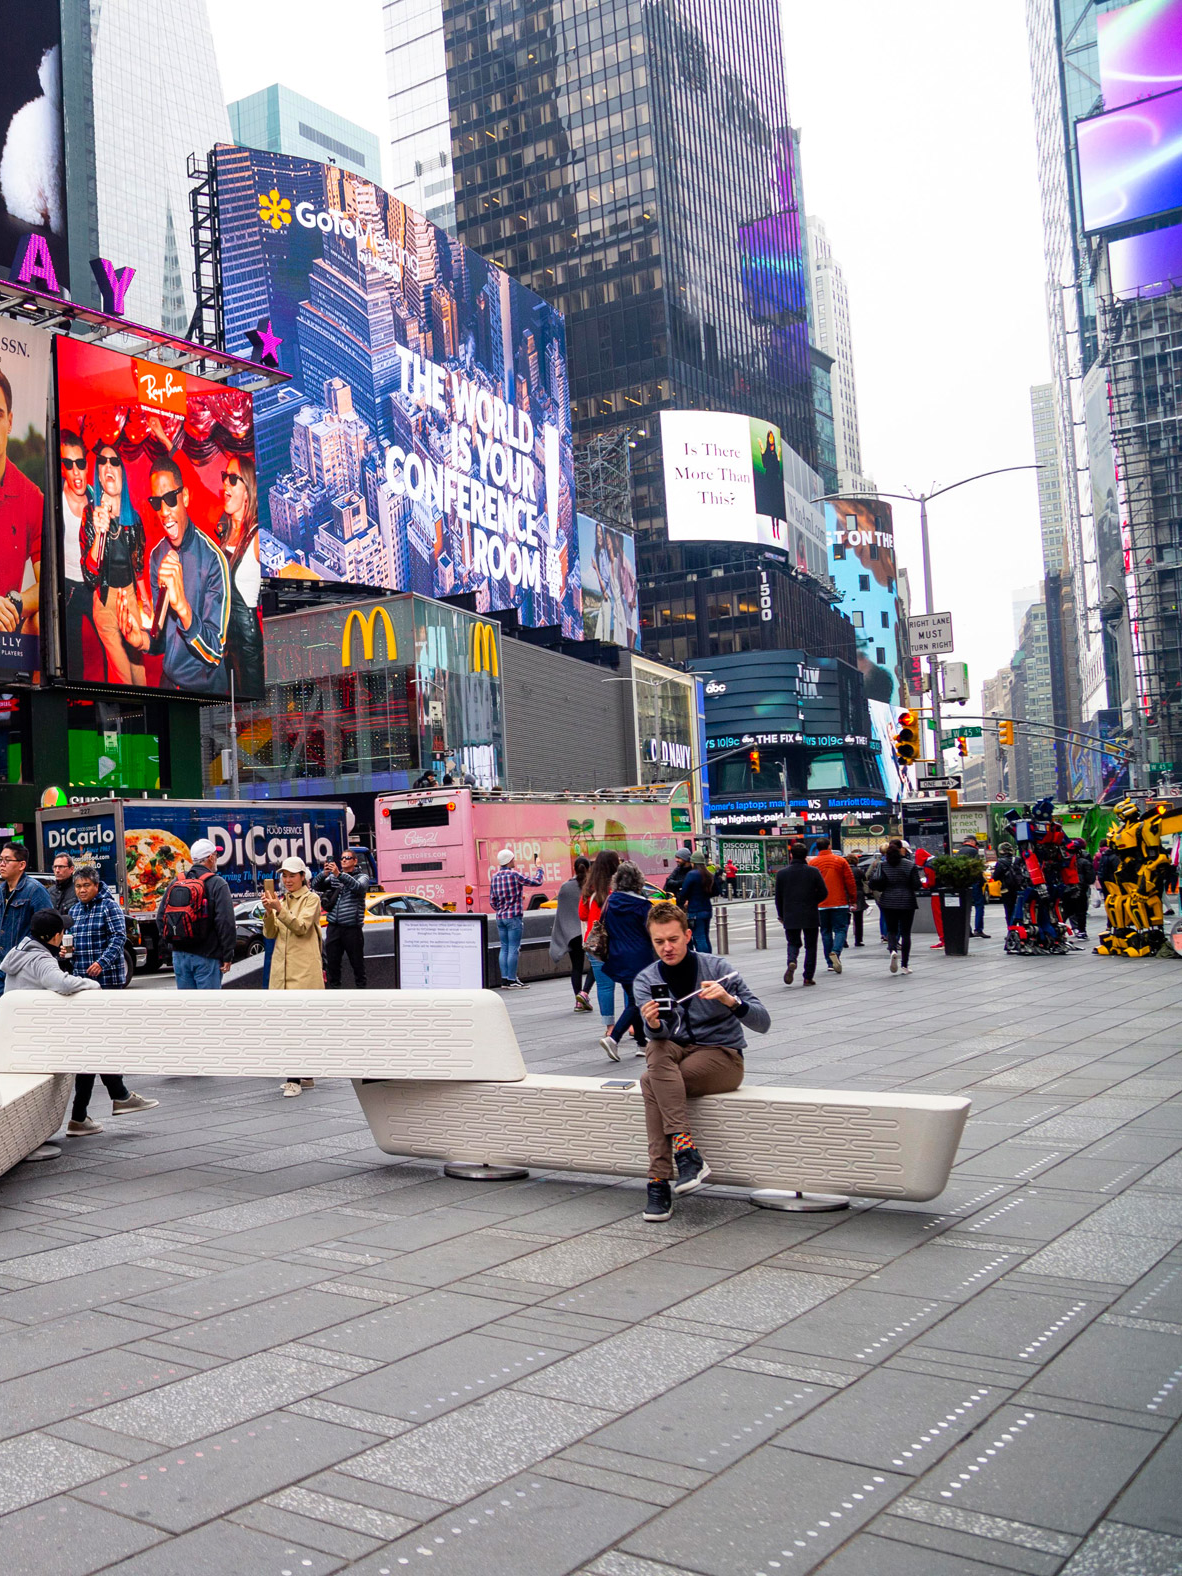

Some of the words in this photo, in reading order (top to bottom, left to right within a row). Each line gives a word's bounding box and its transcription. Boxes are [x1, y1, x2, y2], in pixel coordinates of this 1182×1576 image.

[395, 342, 448, 414] THE
[450, 373, 535, 454] WORLD
[684, 442, 698, 457] Is
[701, 442, 741, 460] There
[450, 420, 473, 473] IS
[476, 431, 536, 503] YOUR
[675, 467, 715, 481] More
[718, 467, 751, 484] Than
[385, 445, 539, 548] CONFERENCE
[697, 490, 736, 506] This?
[847, 530, 873, 547] ON
[473, 526, 542, 594] ROOM
[759, 570, 773, 622] 1500
[909, 619, 930, 629] RIGHT
[932, 617, 951, 626] LANE
[918, 629, 943, 640] MUST
[911, 643, 929, 652] TURN
[931, 640, 953, 650] RIGHT
[1, 650, 24, 658] PLAYERS
[755, 735, 777, 745] THE
[780, 733, 795, 744] FIX
[952, 729, 960, 739] W
[963, 728, 973, 737] 45
[650, 738, 669, 764] OD
[668, 741, 691, 770] NAVY
[941, 779, 955, 787] WAY
[735, 800, 768, 811] laptop;
[973, 812, 984, 820] to
[48, 823, 115, 848] DiCarlo
[266, 826, 283, 835] FOOD
[283, 826, 303, 835] SERVICE
[960, 826, 980, 835] meal
[207, 822, 334, 867] DiCarlo
[722, 842, 760, 850] DISCOVER
[398, 851, 447, 860] C21STORES.COM
[257, 870, 274, 881] Food
[404, 885, 417, 893] UP
[415, 883, 445, 900] 65%
